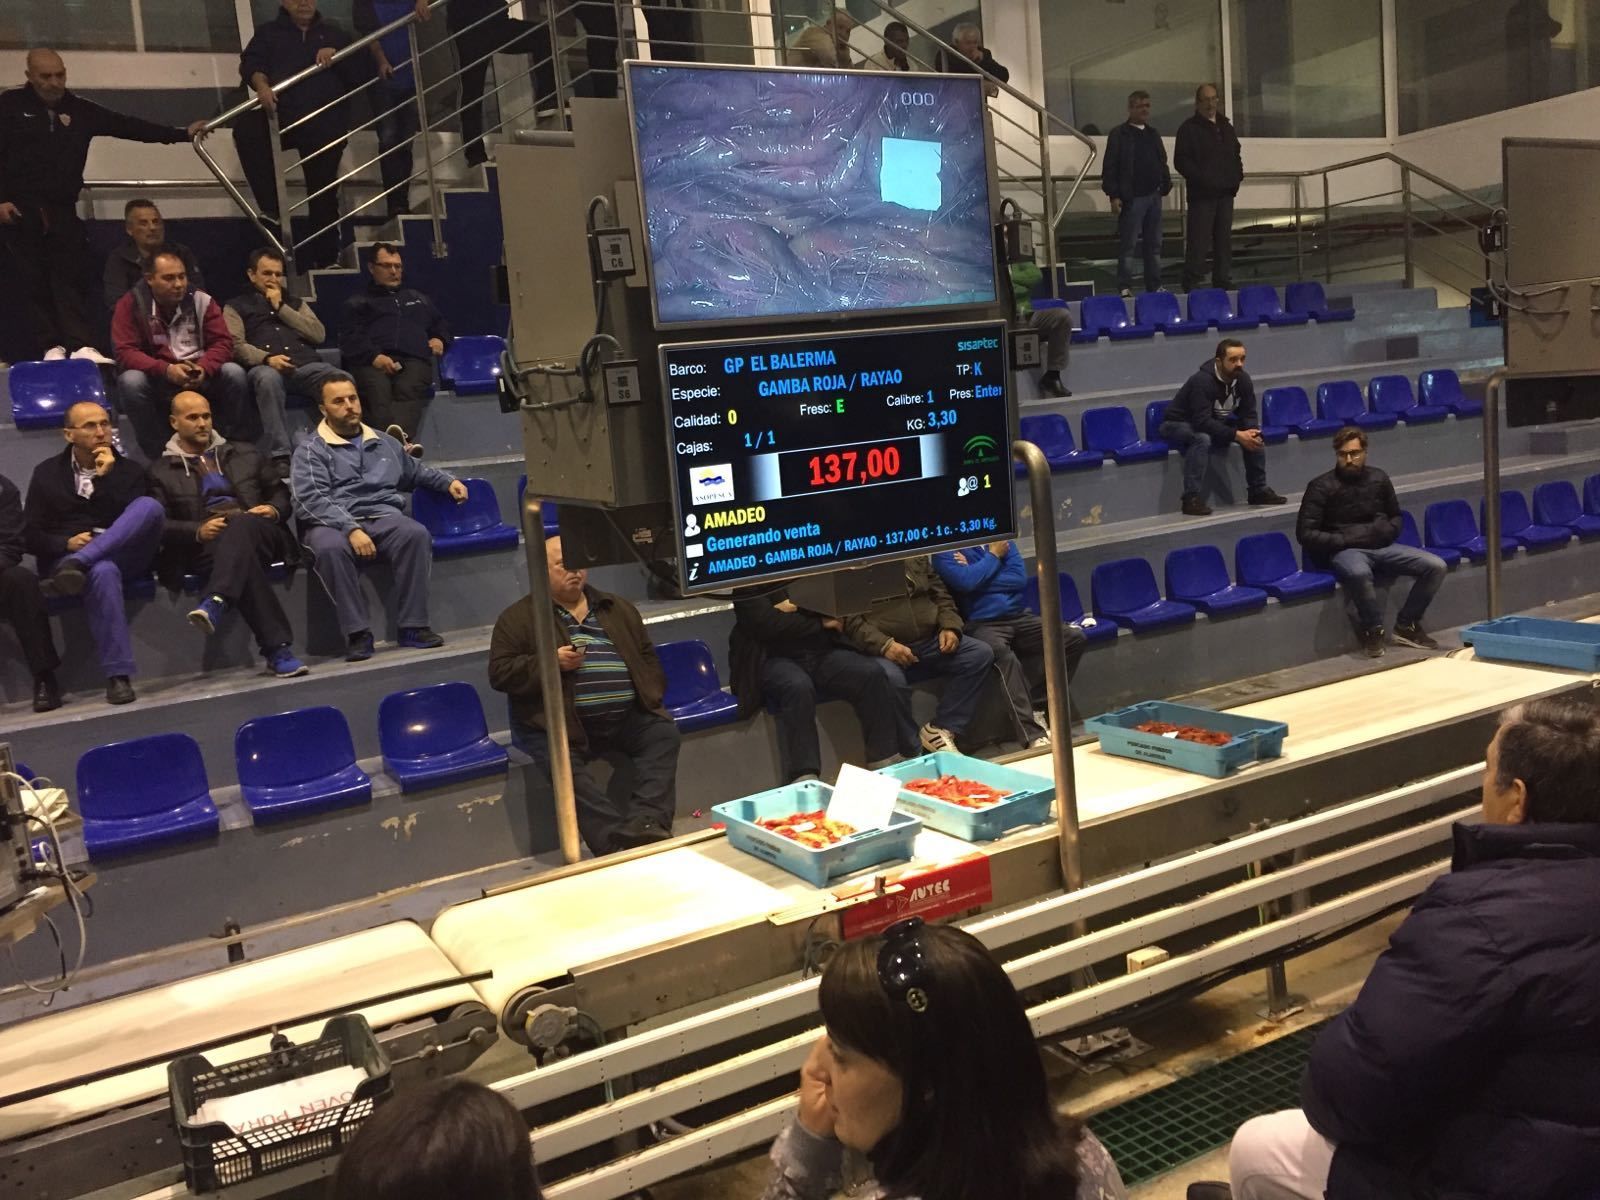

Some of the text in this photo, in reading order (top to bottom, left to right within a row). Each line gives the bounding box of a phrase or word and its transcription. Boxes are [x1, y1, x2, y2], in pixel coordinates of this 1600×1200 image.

[901, 91, 934, 106] 000
[669, 350, 837, 376] Barco: GP EL BALERMA
[956, 361, 983, 376] TP: K
[672, 369, 903, 401] Especie: GAMBA ROJA / RAYAO
[949, 388, 974, 400] Pres:
[800, 398, 845, 416] Fresc: E
[886, 389, 935, 407] Calibre: 1
[674, 409, 738, 429] Calidad: 0
[906, 409, 958, 431] KG: 3,30
[676, 430, 776, 456] Cajas: 1 / 1
[809, 446, 900, 485] 137,00
[983, 474, 991, 488] 1
[704, 505, 766, 530] AMADEO
[706, 523, 821, 552] Generando venta
[708, 555, 757, 575] AMADEO
[765, 547, 805, 565] GAMBA
[807, 543, 833, 558] ROJA
[835, 541, 841, 556] /
[844, 535, 877, 552] RAYAO
[885, 528, 920, 545] 137,00
[921, 527, 929, 539] €
[936, 525, 942, 537] 1
[959, 519, 981, 533] 3,30
[982, 517, 998, 531] Kg.
[909, 879, 951, 902] AUTEC
